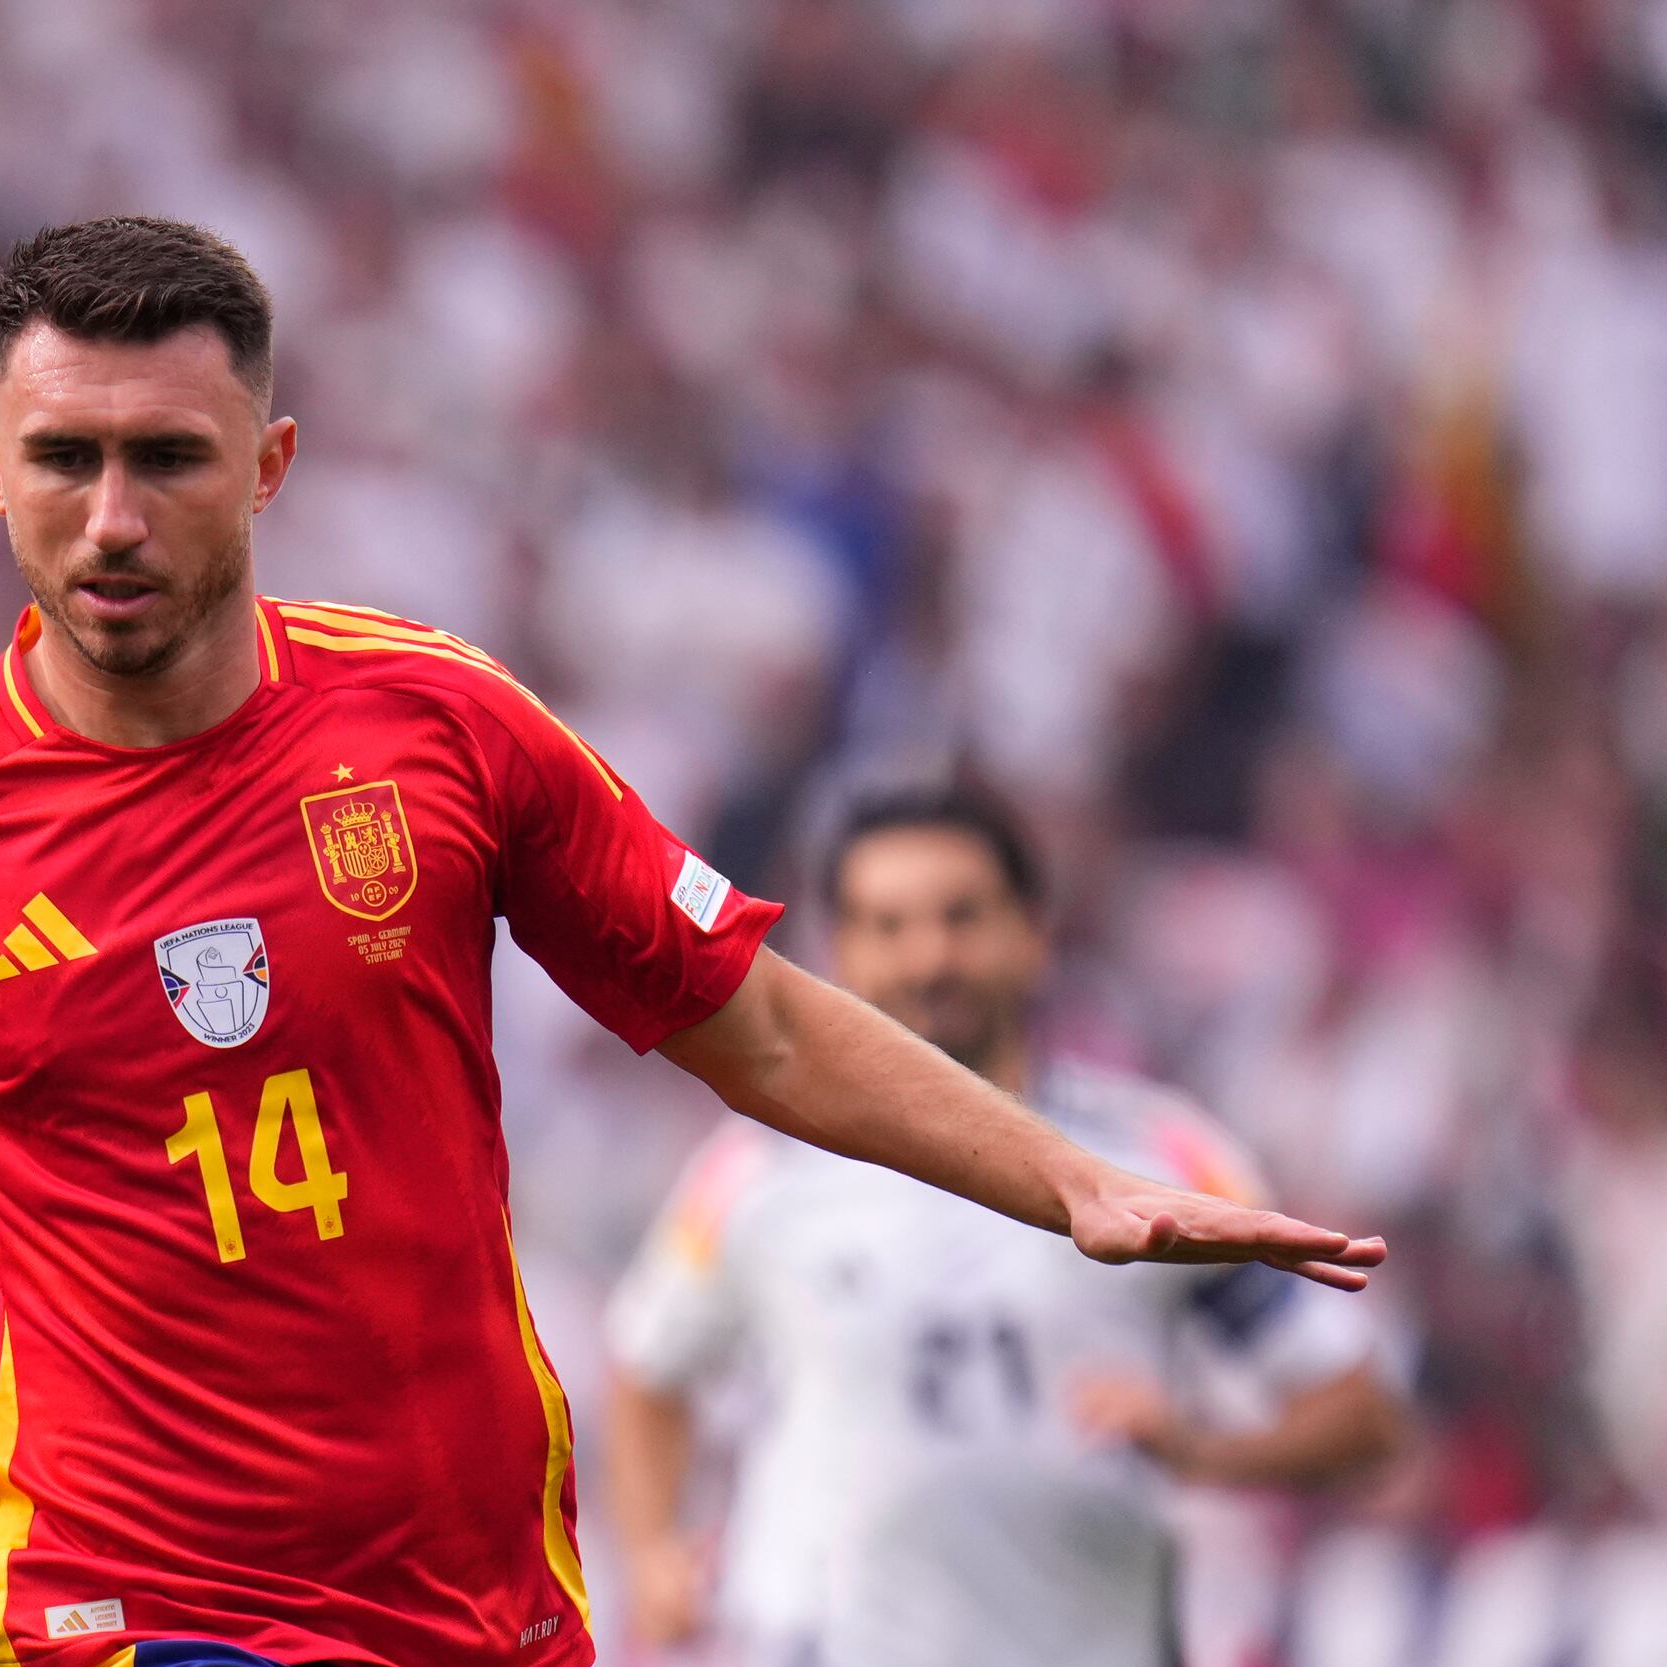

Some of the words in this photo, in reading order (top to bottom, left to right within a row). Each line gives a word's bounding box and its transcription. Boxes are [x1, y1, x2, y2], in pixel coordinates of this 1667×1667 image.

[160, 937, 182, 950] UEFA
[182, 926, 218, 941] NATIONS
[220, 922, 254, 932] LEAGUE
[347, 934, 370, 946] SPAIN
[378, 925, 412, 940] GERMANY
[358, 945, 369, 955] 05
[370, 941, 387, 953] JULY
[388, 938, 406, 949] 2024
[365, 949, 403, 965] STUTTGART
[204, 1032, 237, 1044] WINNER
[239, 1023, 256, 1038] 2023
[165, 1068, 348, 1264] 14
